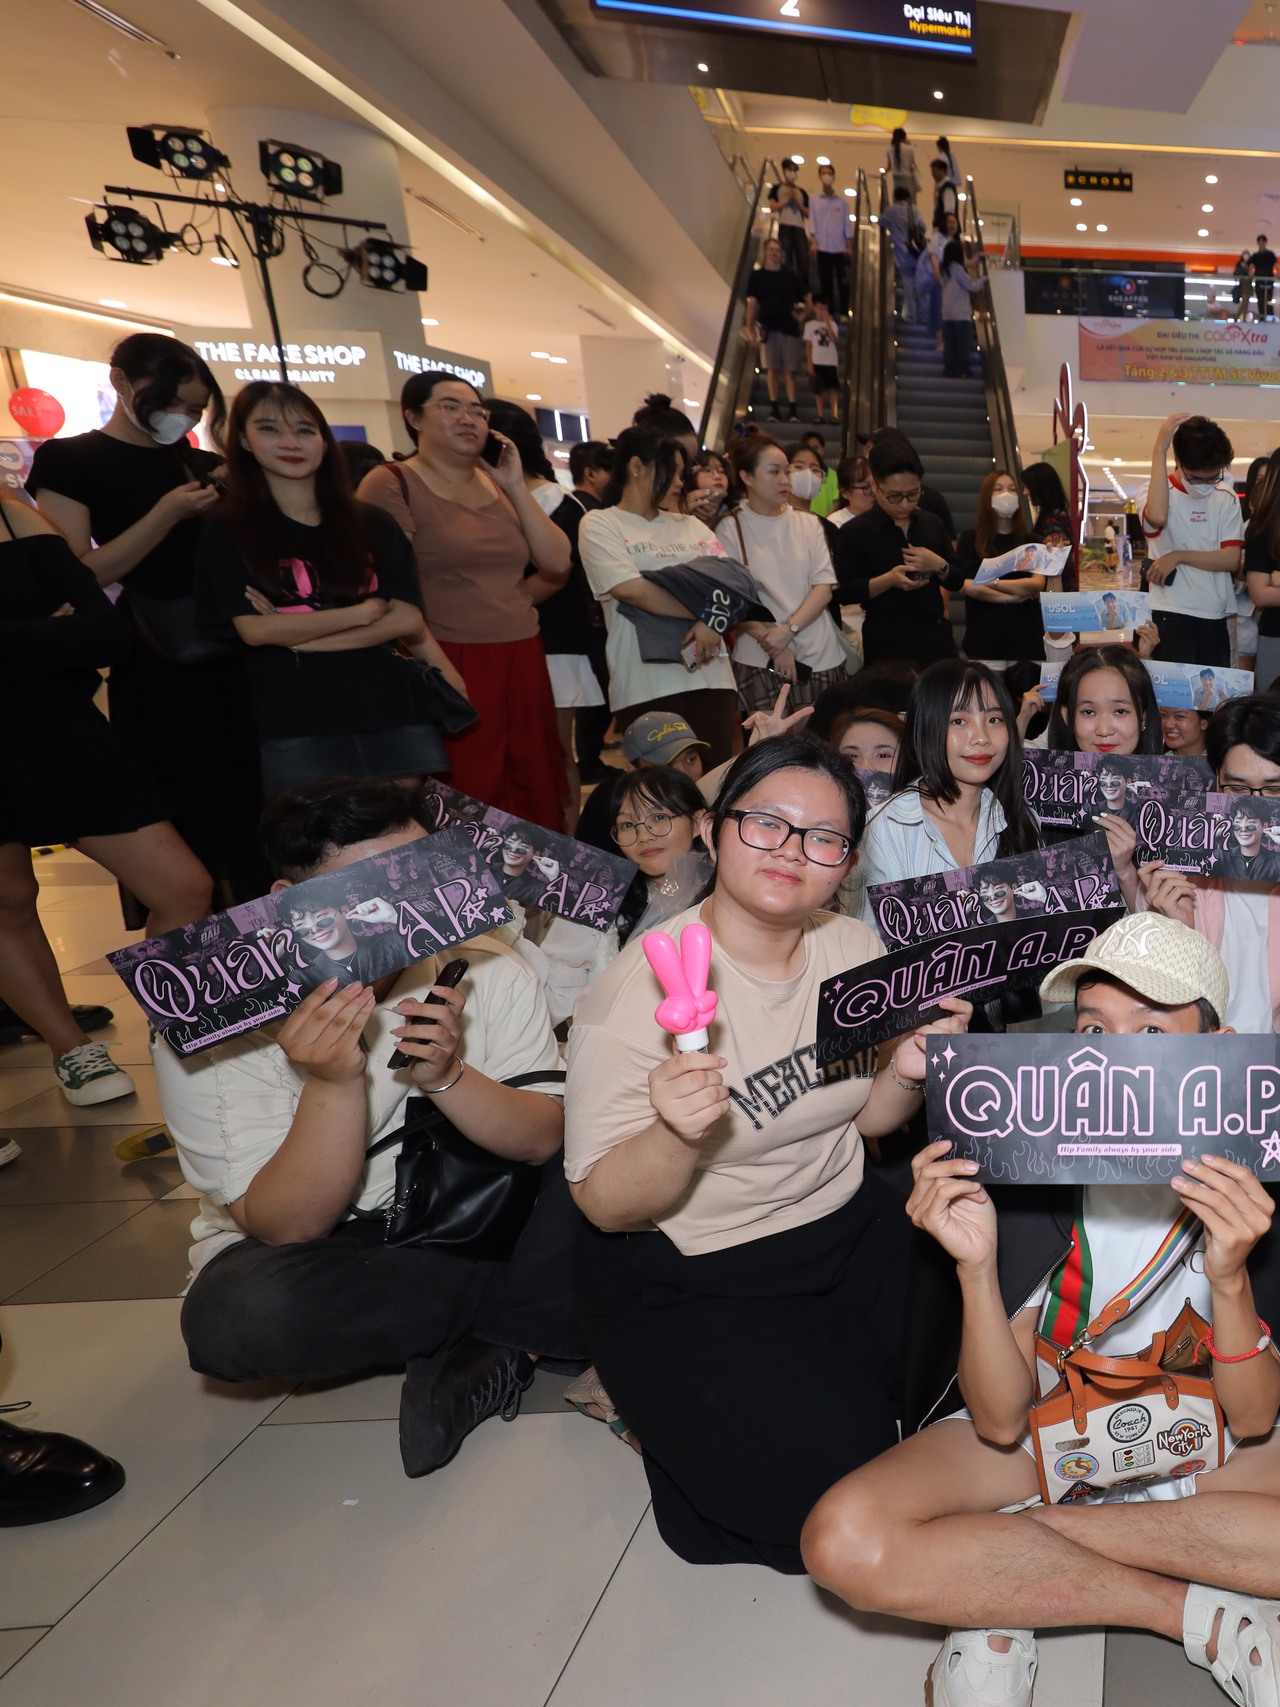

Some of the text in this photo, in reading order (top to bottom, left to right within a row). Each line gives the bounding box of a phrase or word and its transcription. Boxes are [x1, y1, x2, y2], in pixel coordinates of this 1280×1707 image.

[927, 6, 952, 23] Siêu
[909, 19, 972, 38] Hypermarket
[1078, 175, 1131, 187] CROSS
[194, 341, 242, 362] THE
[303, 344, 367, 366] SHOP
[393, 350, 422, 372] THE
[1158, 367, 1166, 377] 2
[1168, 366, 1179, 378] &
[1180, 367, 1189, 379] 3
[1190, 367, 1226, 380] TTTM
[1021, 759, 1100, 806] Quân
[1139, 800, 1233, 851] Quân
[878, 874, 1102, 945] Quân AP
[134, 928, 309, 1023] Quân
[834, 941, 996, 1028] QUÂN
[184, 1008, 281, 1050] Hip Family always by your side
[945, 1045, 1155, 1138] QUÂN
[1060, 1146, 1075, 1154] Hip
[1076, 1146, 1102, 1154] Family
[1104, 1146, 1129, 1154] always
[1130, 1146, 1141, 1154] by
[1113, 1412, 1147, 1430] Coach
[1124, 1425, 1138, 1433] 1941
[1172, 1441, 1194, 1455] City
